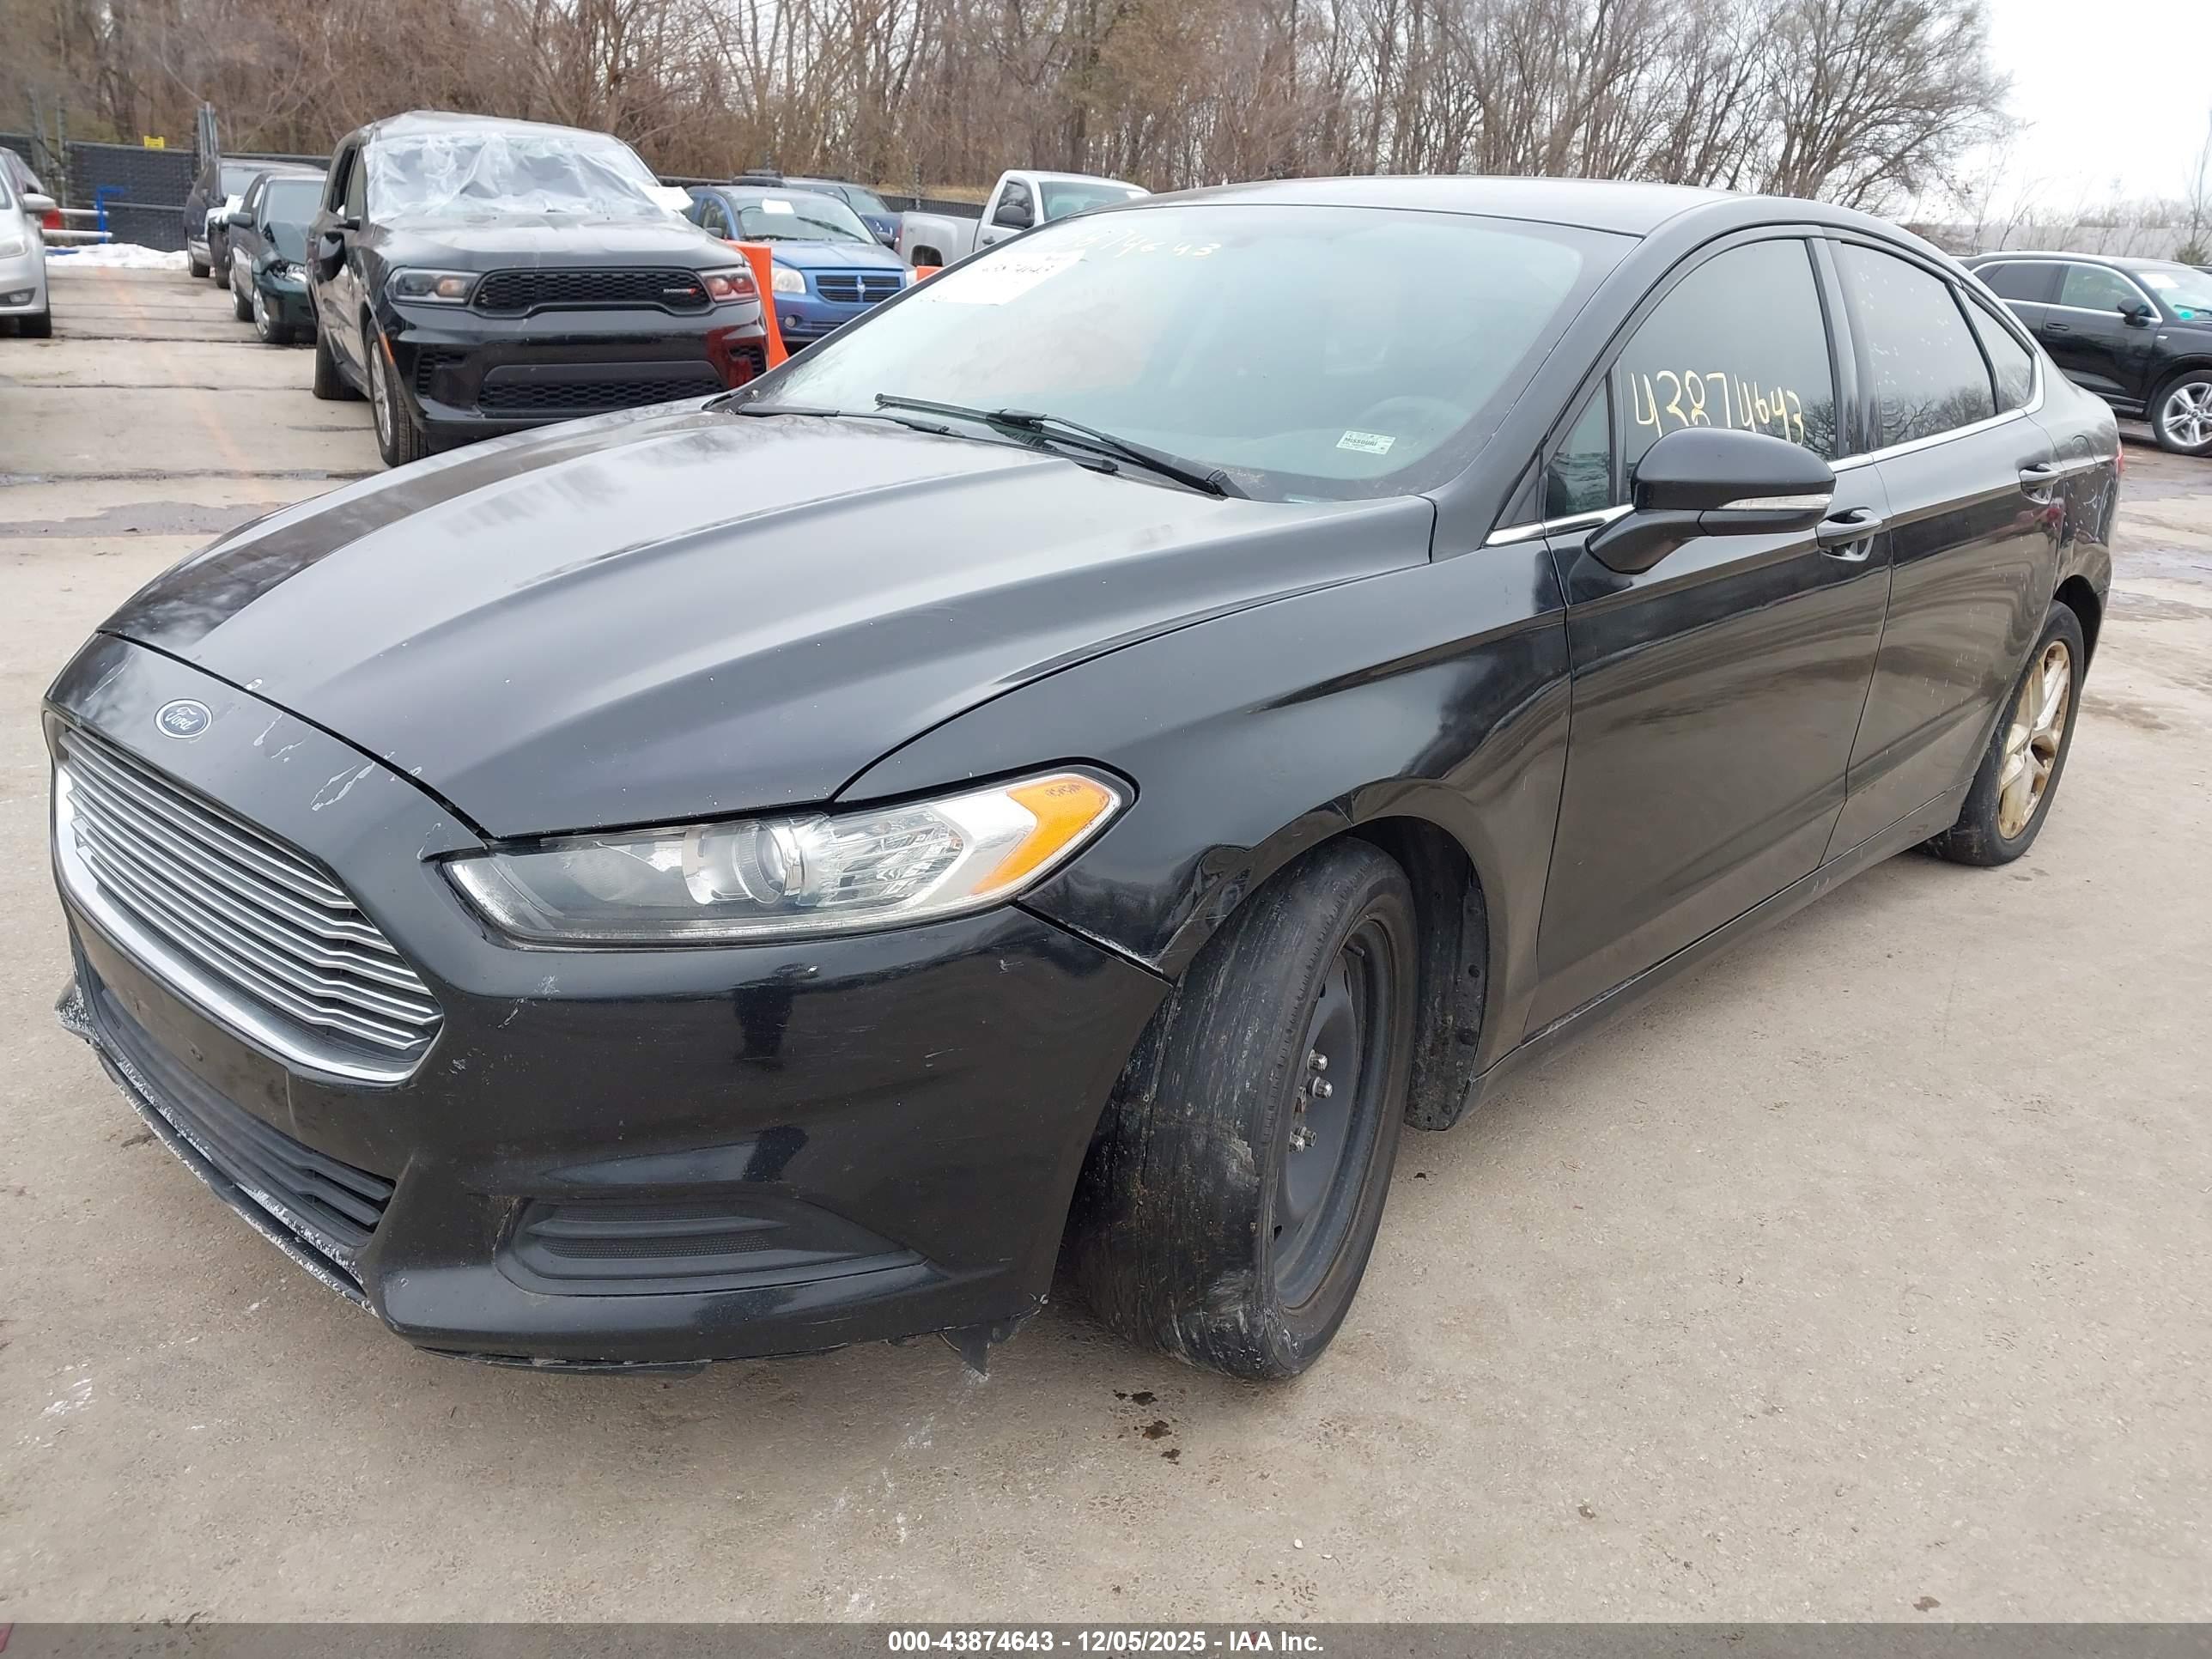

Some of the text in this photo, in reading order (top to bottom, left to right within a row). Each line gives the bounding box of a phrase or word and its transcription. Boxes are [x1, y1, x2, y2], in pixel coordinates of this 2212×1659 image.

[1630, 369, 1804, 447] 43874643
[1344, 437, 1378, 447] MISSOURI
[164, 706, 199, 731] Ford
